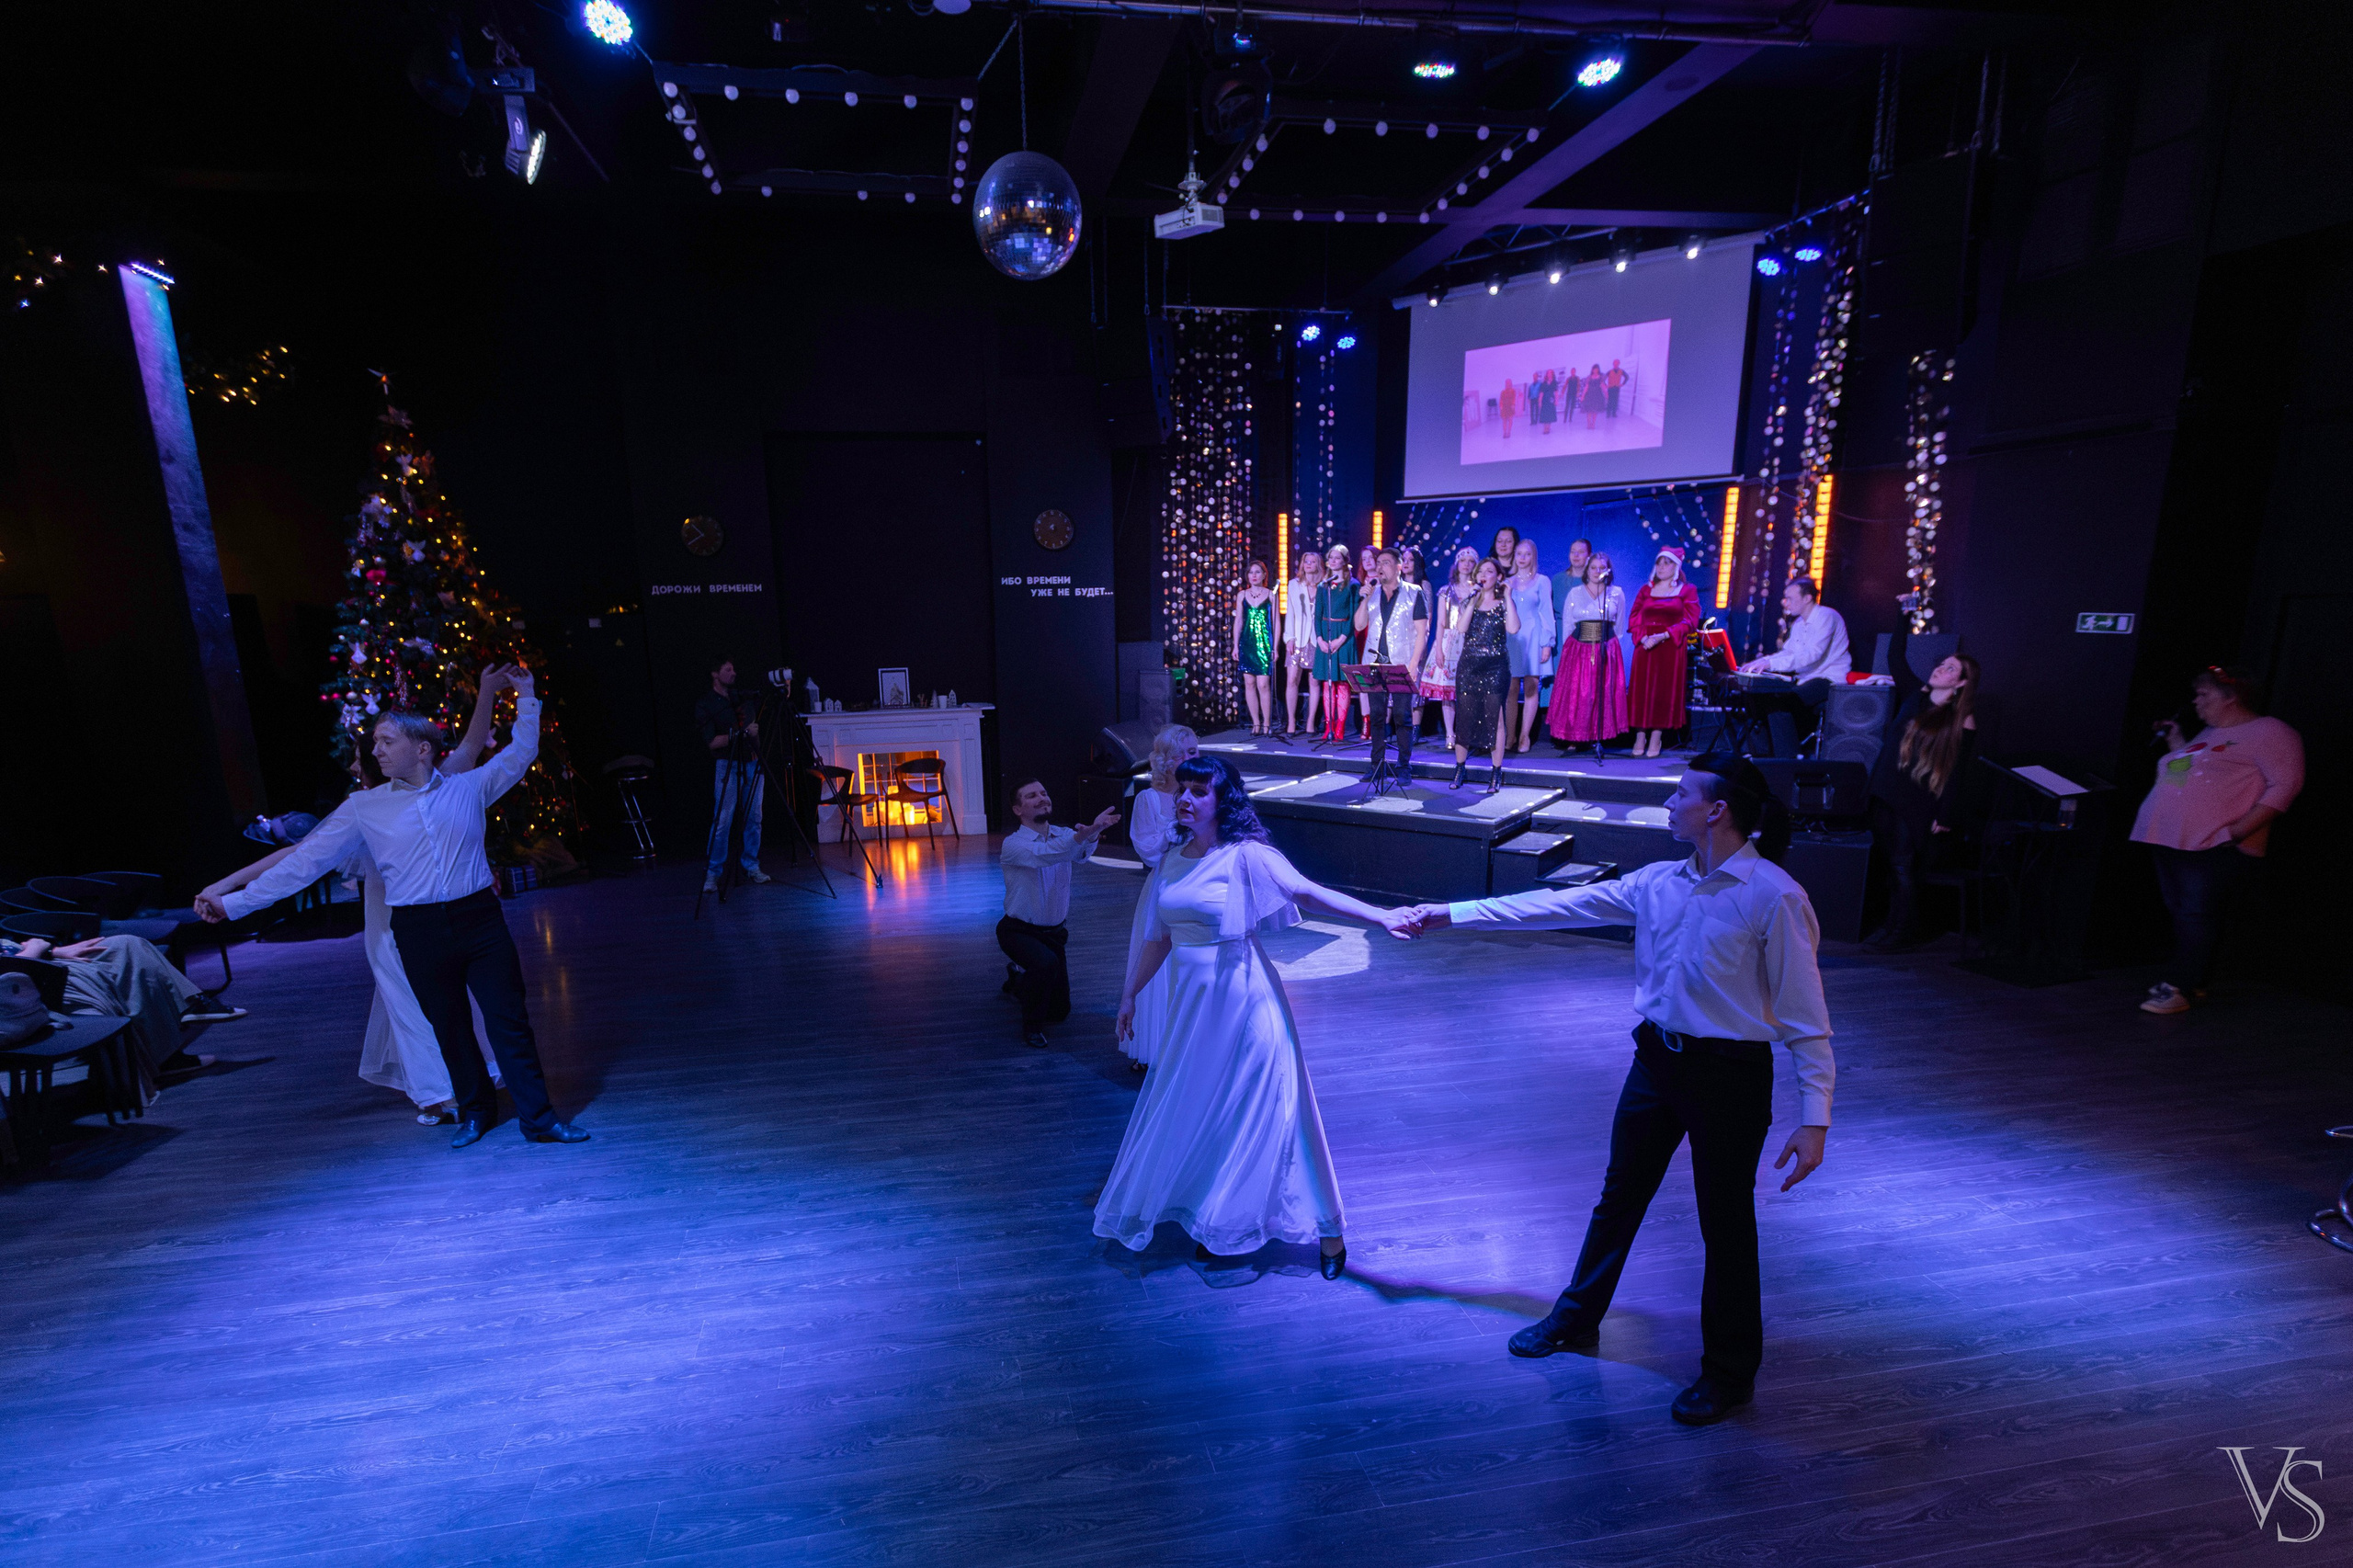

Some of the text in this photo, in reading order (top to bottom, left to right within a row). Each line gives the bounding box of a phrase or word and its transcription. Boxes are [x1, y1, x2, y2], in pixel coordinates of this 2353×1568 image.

[1001, 575, 1072, 585] ИБО ВРЕМЕНИ
[651, 584, 763, 596] ДОРОЖИ ВРЕМЕНЕМ
[1030, 586, 1114, 597] УЖЕ НЕ БУДЕТ...
